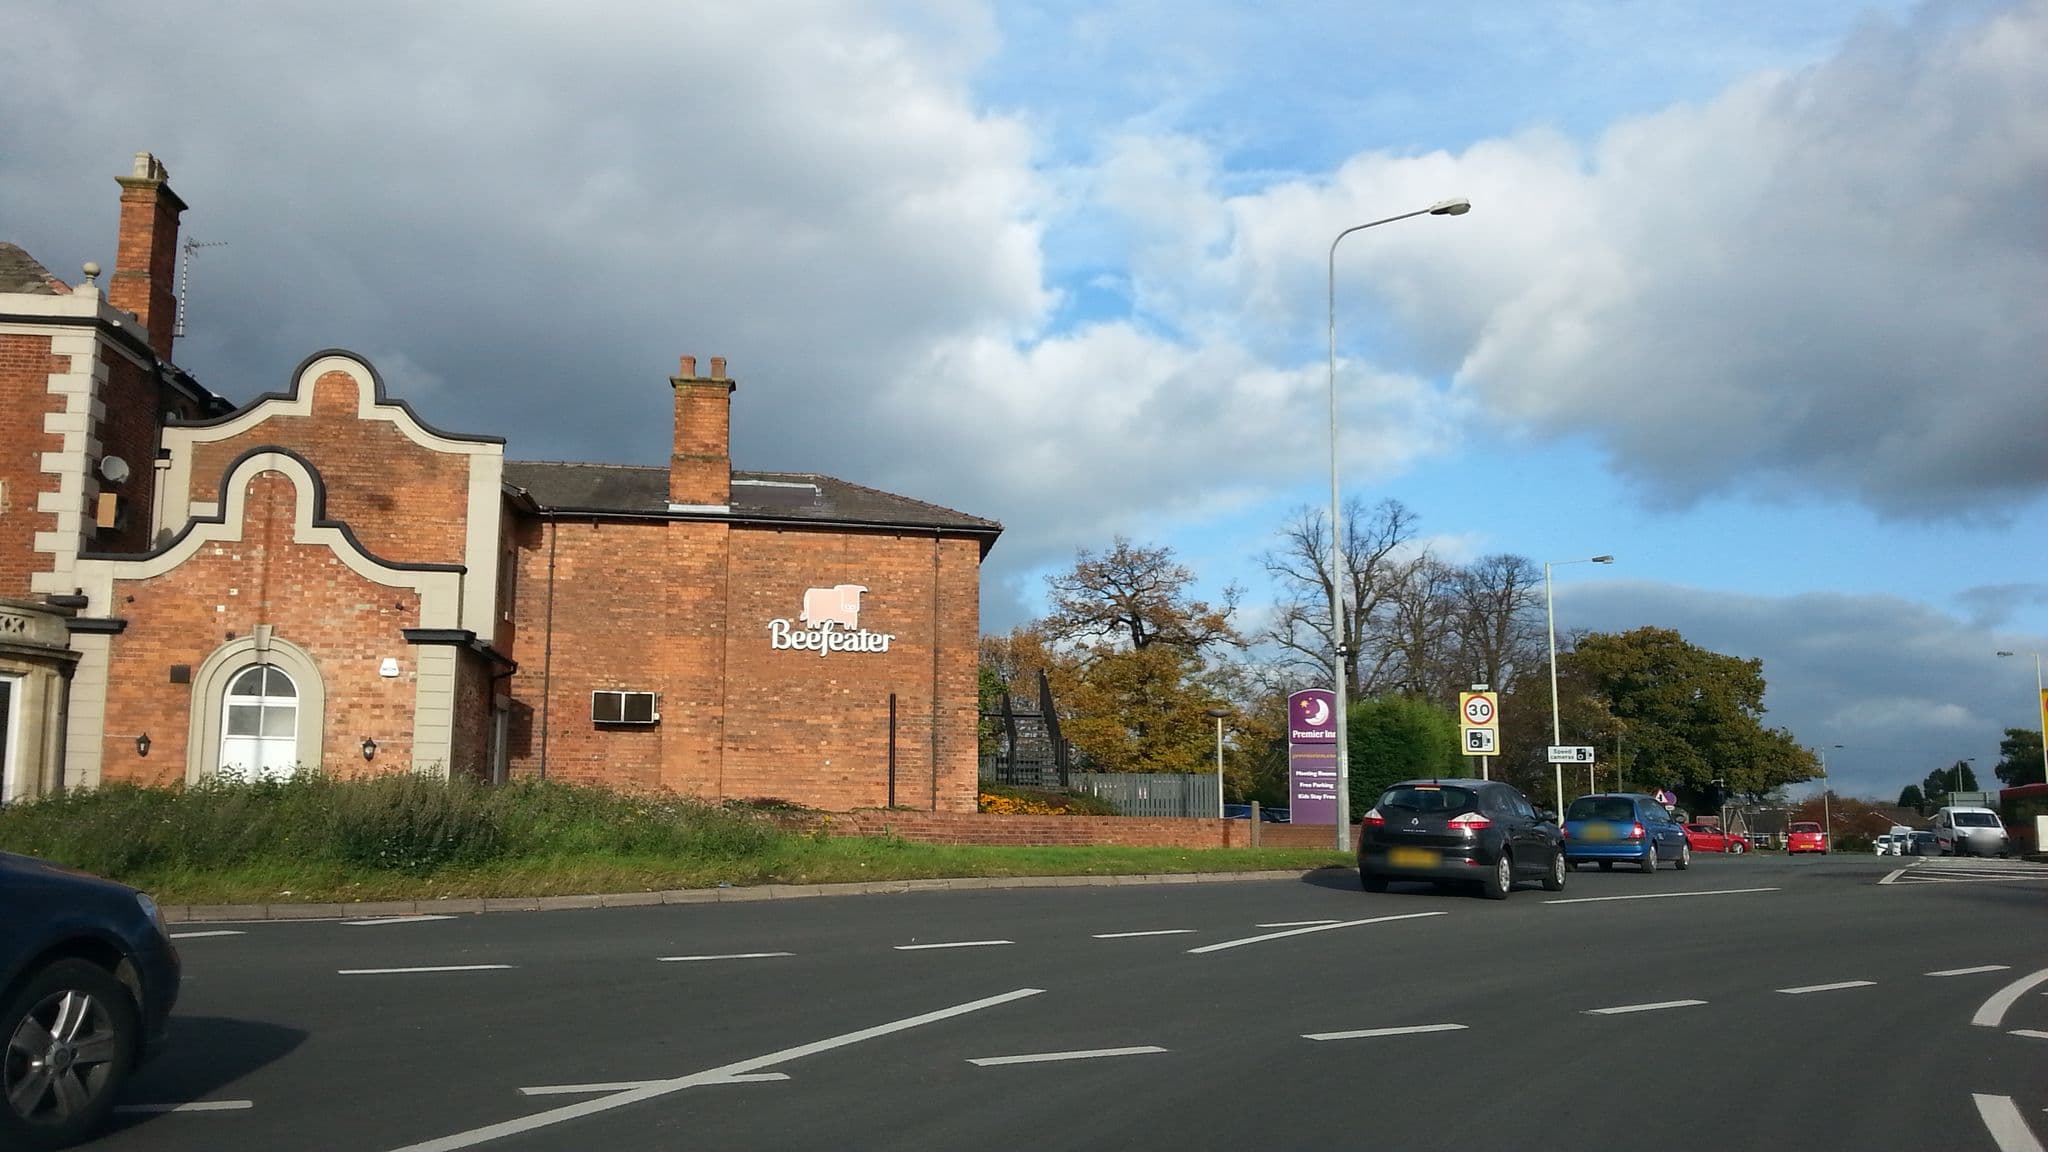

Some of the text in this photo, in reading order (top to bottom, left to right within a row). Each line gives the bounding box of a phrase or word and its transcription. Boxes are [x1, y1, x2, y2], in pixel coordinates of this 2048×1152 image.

[767, 618, 896, 657] Beefeater
[1468, 704, 1490, 716] 30
[1292, 729, 1324, 738] Premier
